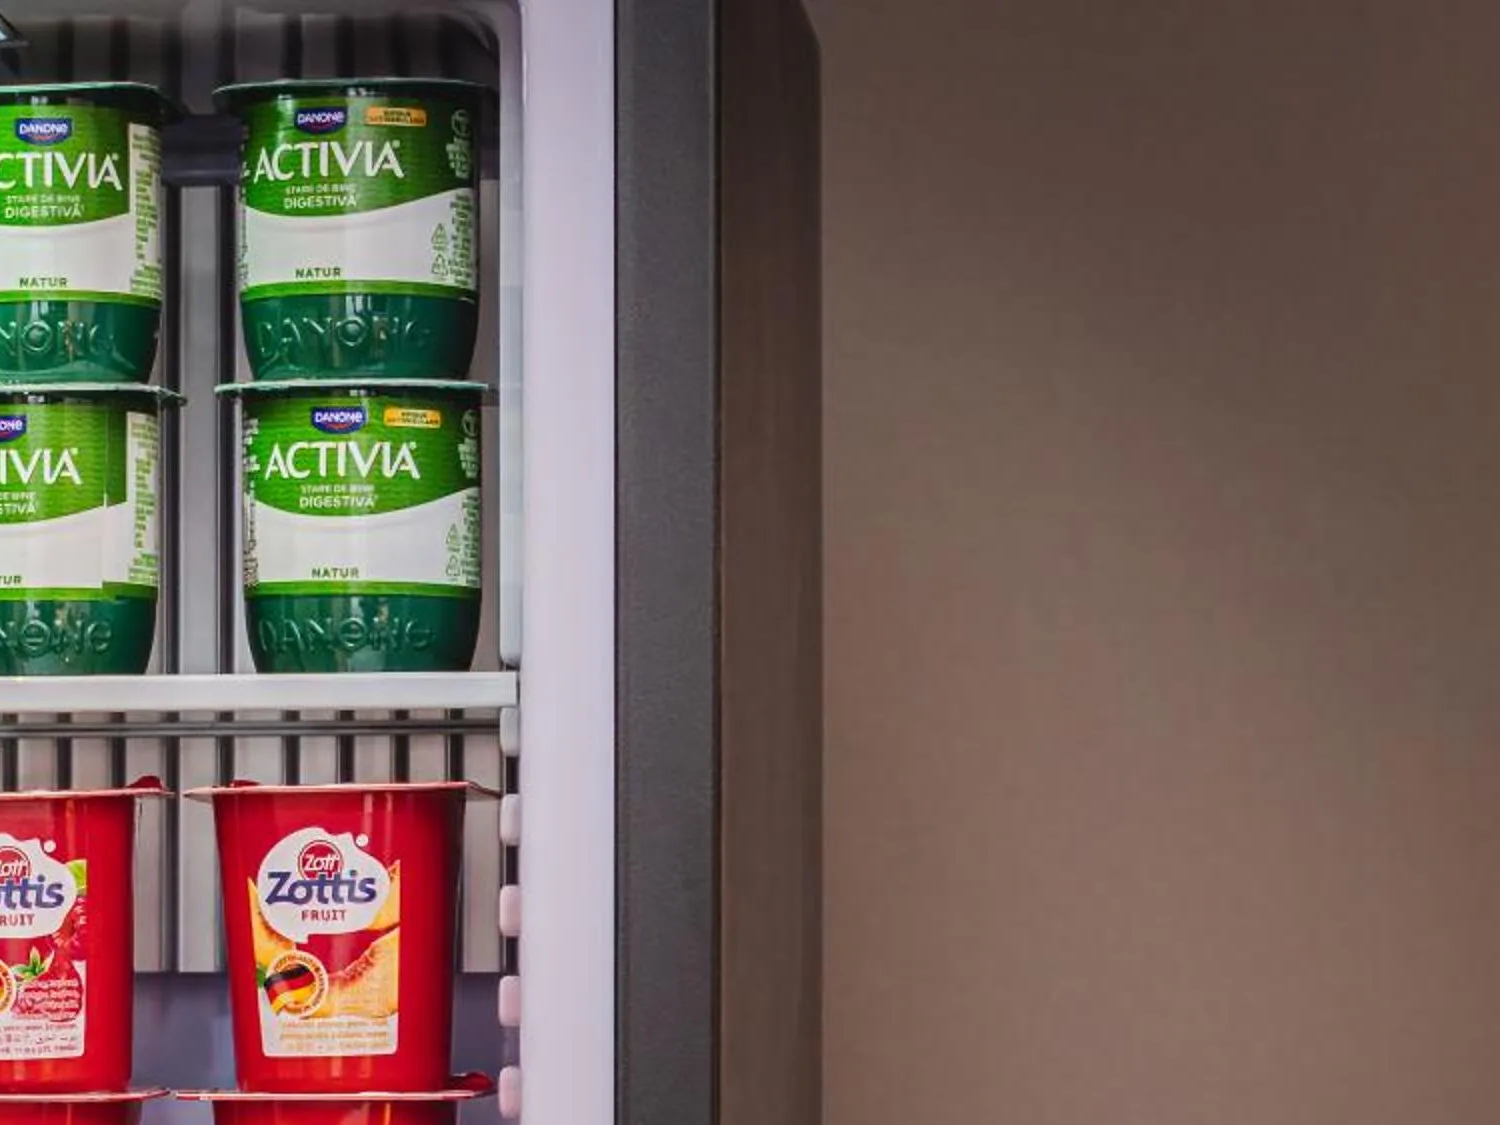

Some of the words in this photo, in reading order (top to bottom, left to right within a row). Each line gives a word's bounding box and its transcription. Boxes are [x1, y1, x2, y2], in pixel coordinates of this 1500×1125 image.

[252, 140, 405, 184] ACTIVIA
[295, 267, 342, 279] NATUR
[19, 276, 68, 288] NATUR
[264, 440, 421, 481] ACTIVIA
[311, 567, 360, 579] NATUR
[303, 853, 341, 871] Zott
[265, 869, 377, 905] Zottis
[301, 909, 347, 922] FRUIT
